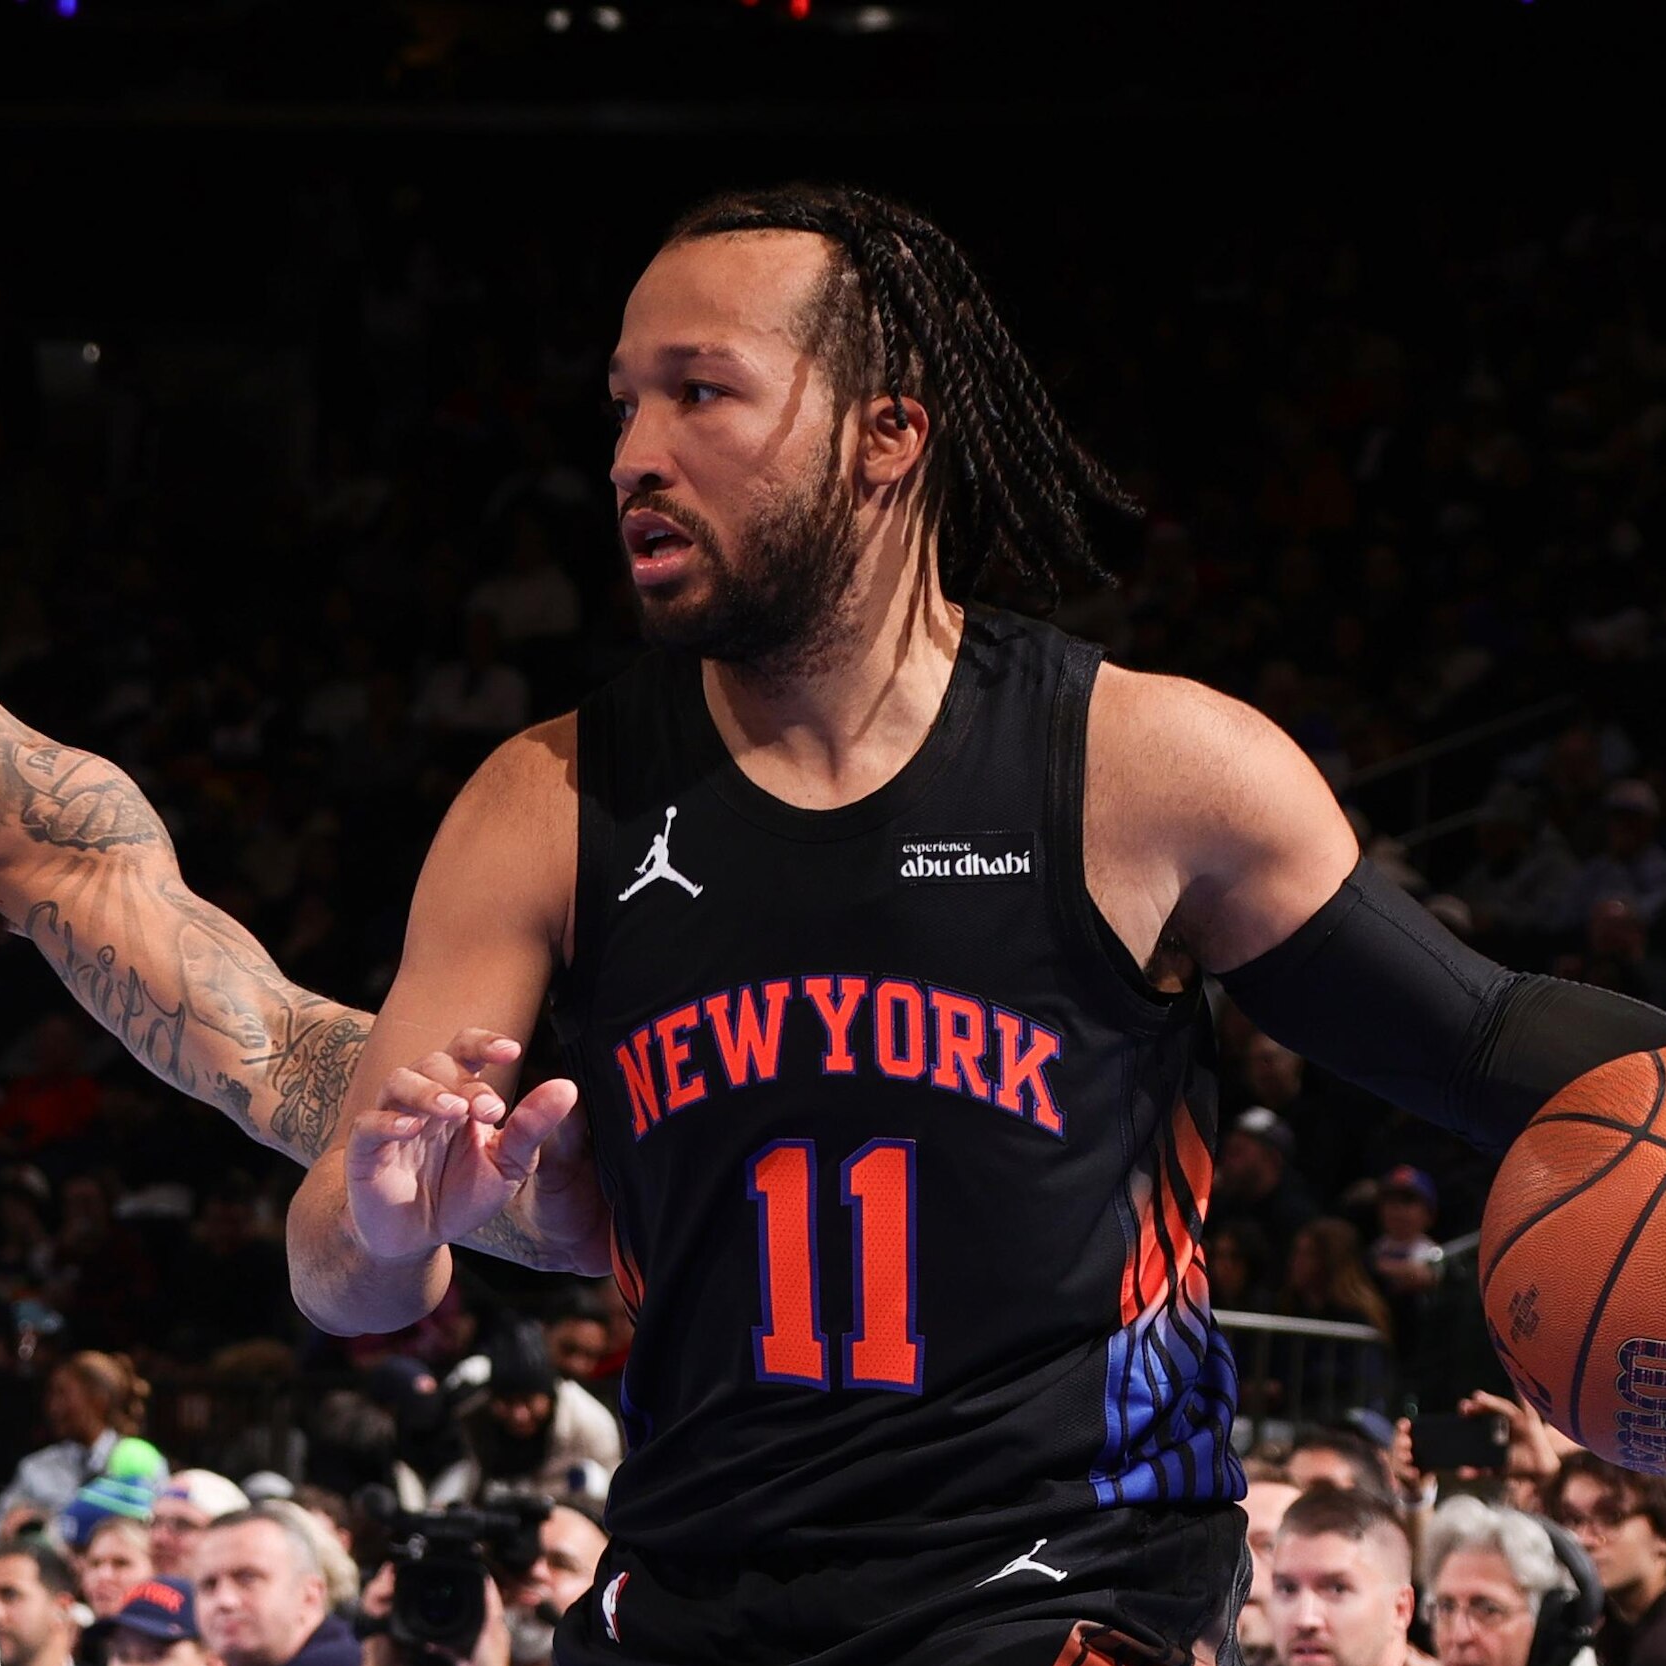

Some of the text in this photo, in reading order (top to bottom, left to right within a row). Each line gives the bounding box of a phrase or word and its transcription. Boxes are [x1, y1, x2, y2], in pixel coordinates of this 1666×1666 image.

[900, 854, 951, 877] abu
[902, 841, 971, 854] experience
[613, 973, 1067, 1142] NEW YORK
[745, 1137, 925, 1396] 11
